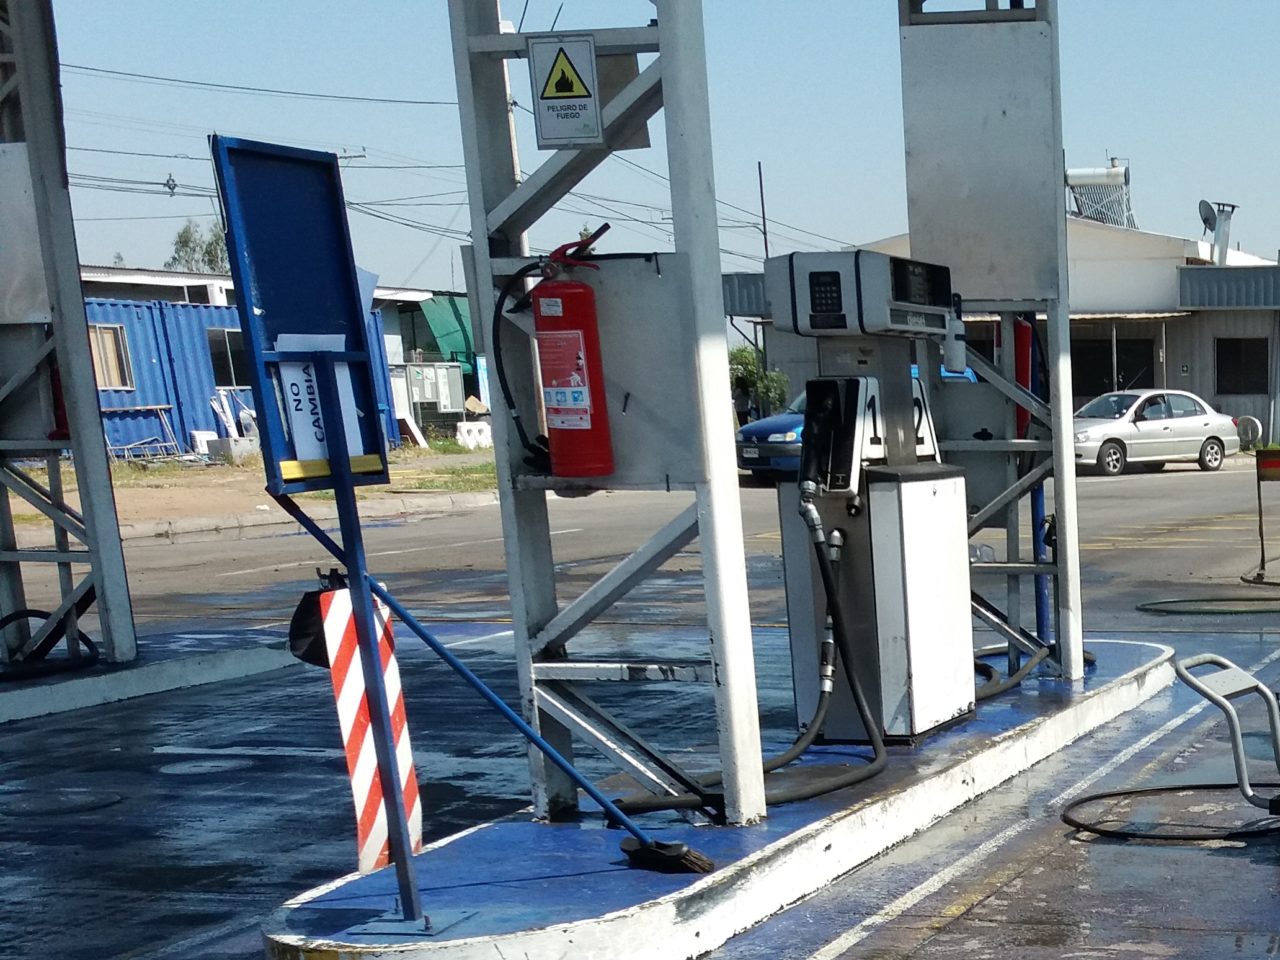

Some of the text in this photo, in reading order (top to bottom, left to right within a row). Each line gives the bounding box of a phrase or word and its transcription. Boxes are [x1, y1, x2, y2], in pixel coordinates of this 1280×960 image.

[547, 103, 588, 112] PELIGRO DE
[290, 382, 303, 412] NO
[867, 395, 882, 445] 1
